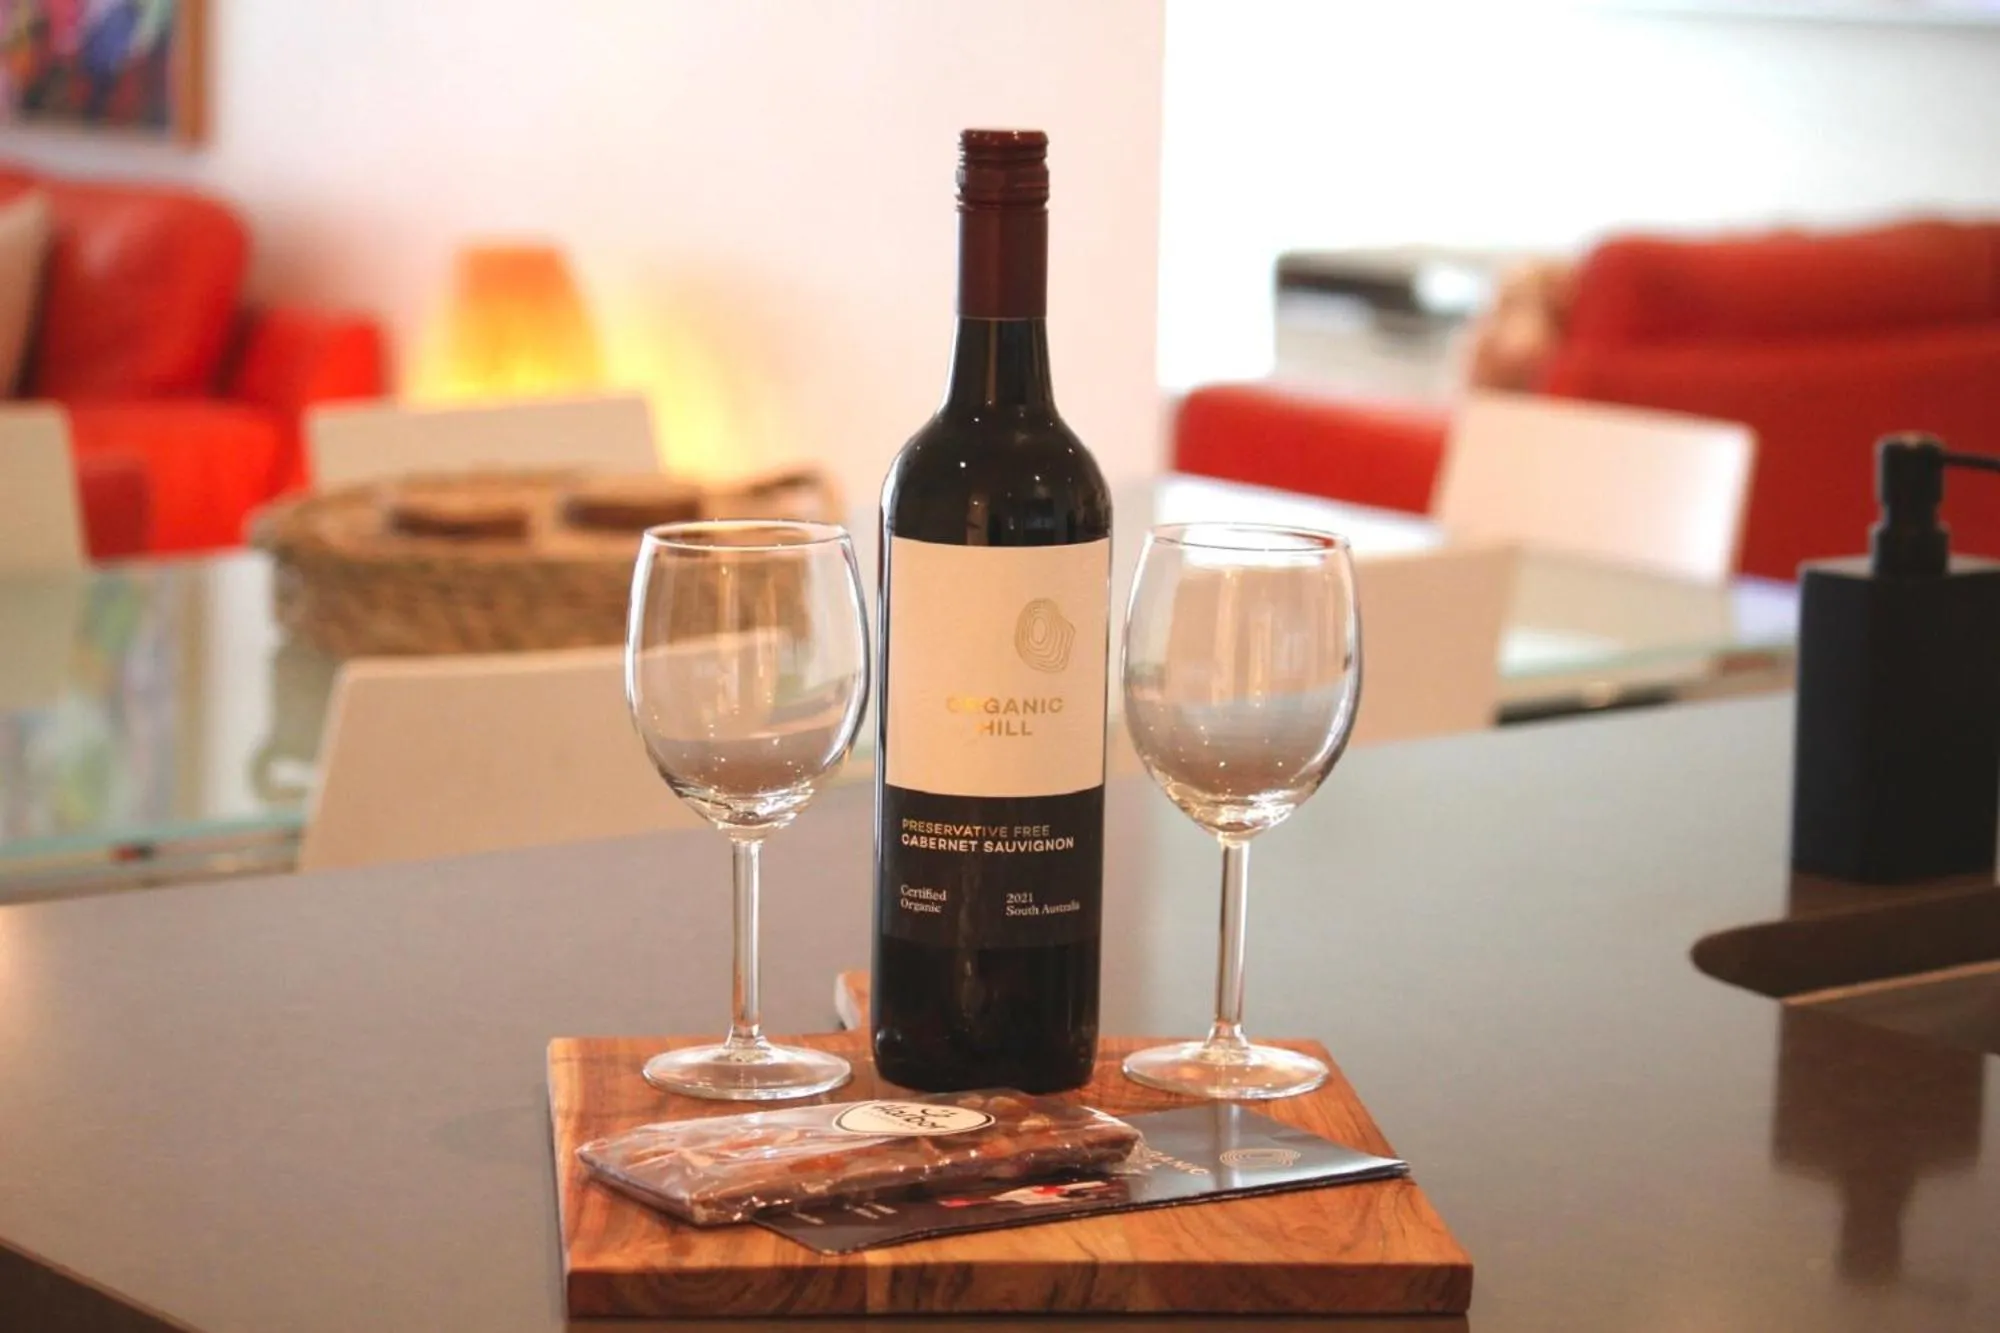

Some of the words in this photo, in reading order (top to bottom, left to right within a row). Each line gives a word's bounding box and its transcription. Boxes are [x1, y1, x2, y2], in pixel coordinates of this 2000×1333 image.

[902, 818, 1008, 838] PRESERVATIVE
[1013, 825, 1051, 838] FREE
[901, 833, 978, 852] CABERNET
[984, 836, 1074, 853] SAUVIGNON
[900, 884, 947, 901] Certified
[1006, 892, 1033, 904] 2021
[900, 898, 942, 914] Organic
[1005, 905, 1039, 917] South
